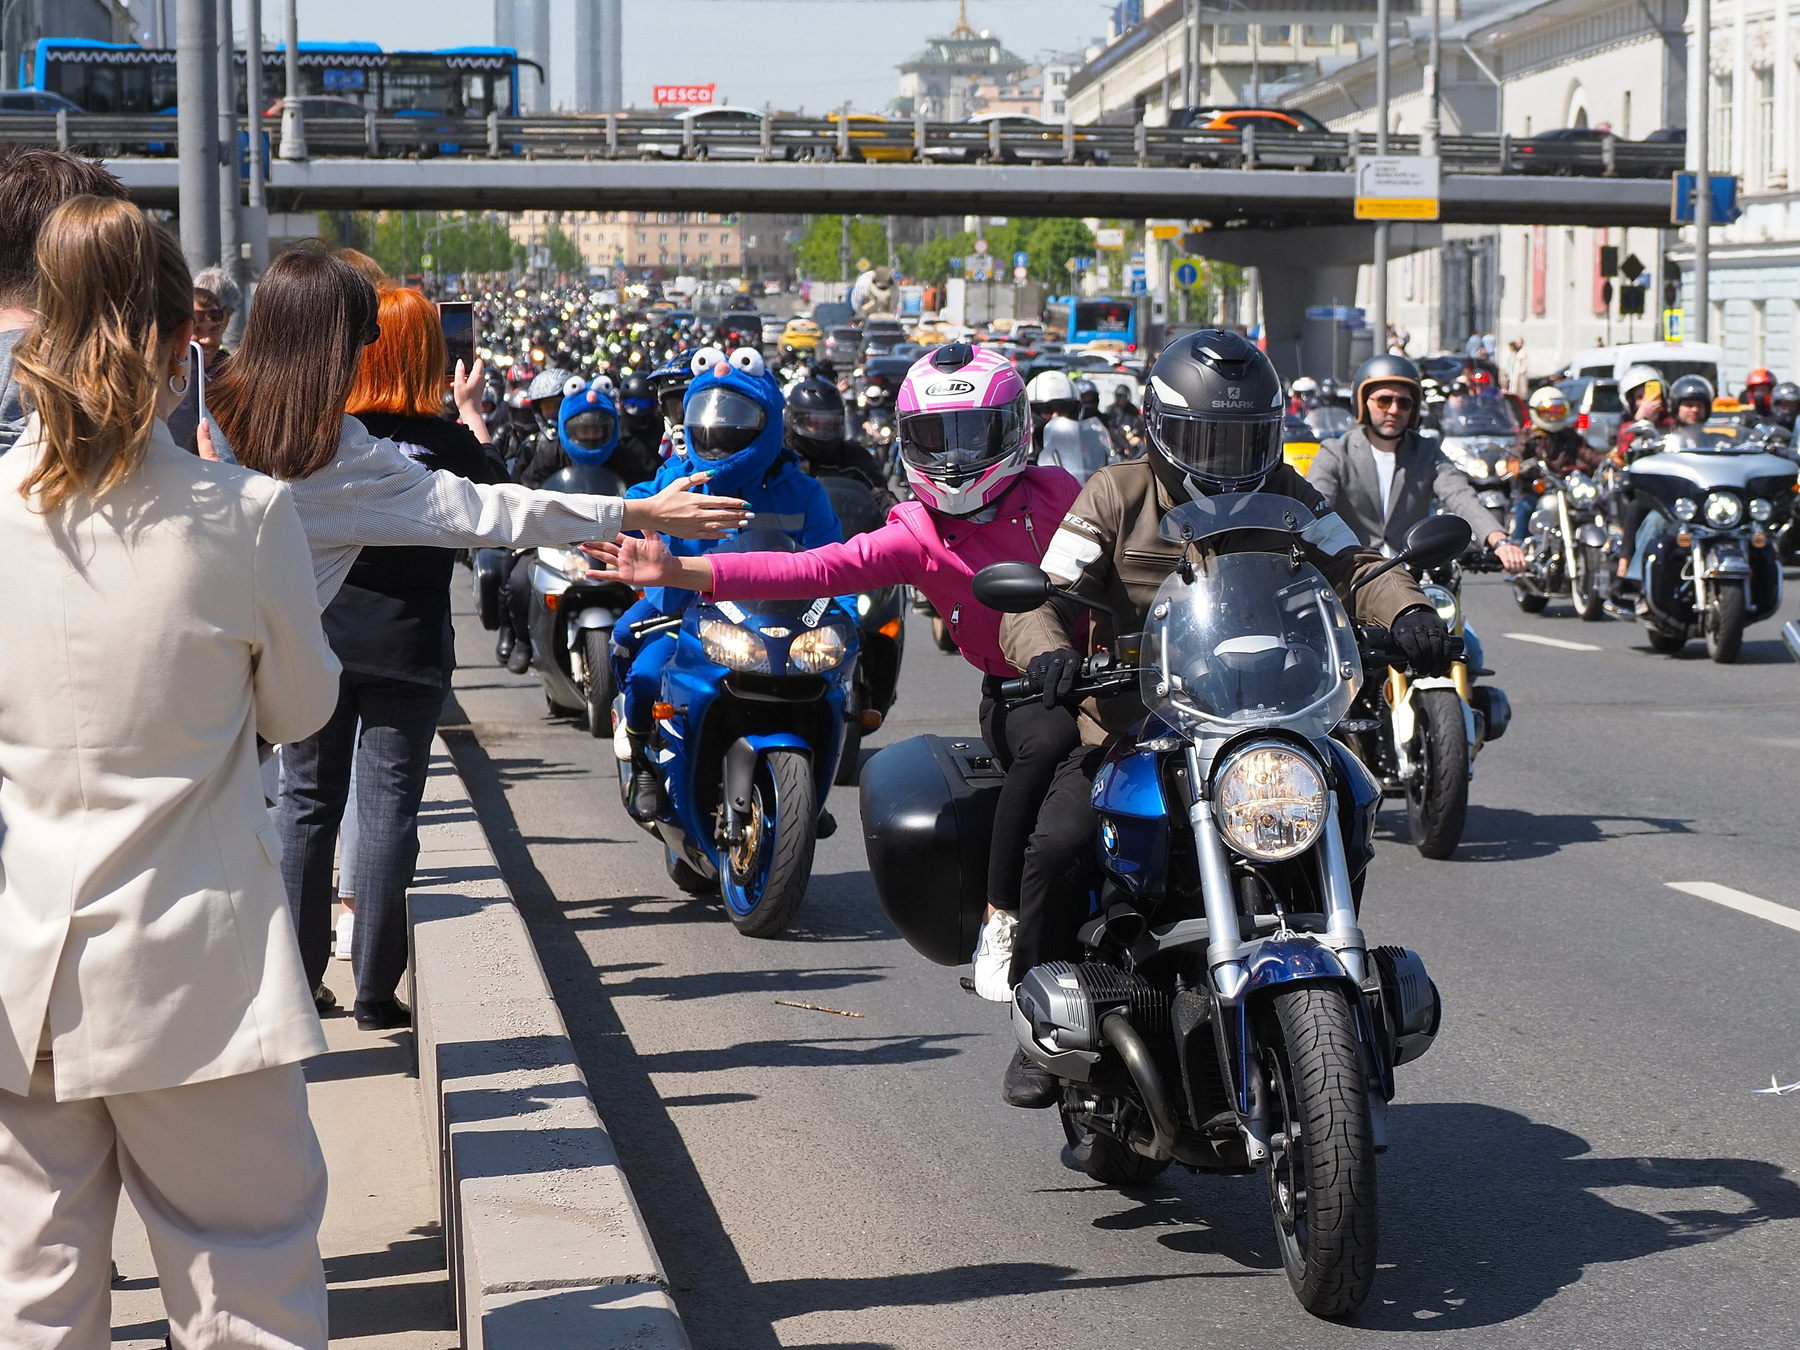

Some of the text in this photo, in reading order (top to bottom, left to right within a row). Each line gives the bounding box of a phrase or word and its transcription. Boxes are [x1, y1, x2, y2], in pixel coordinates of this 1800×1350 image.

[657, 88, 711, 102] PESCO
[930, 382, 969, 395] HJC
[1211, 400, 1254, 409] SHARK
